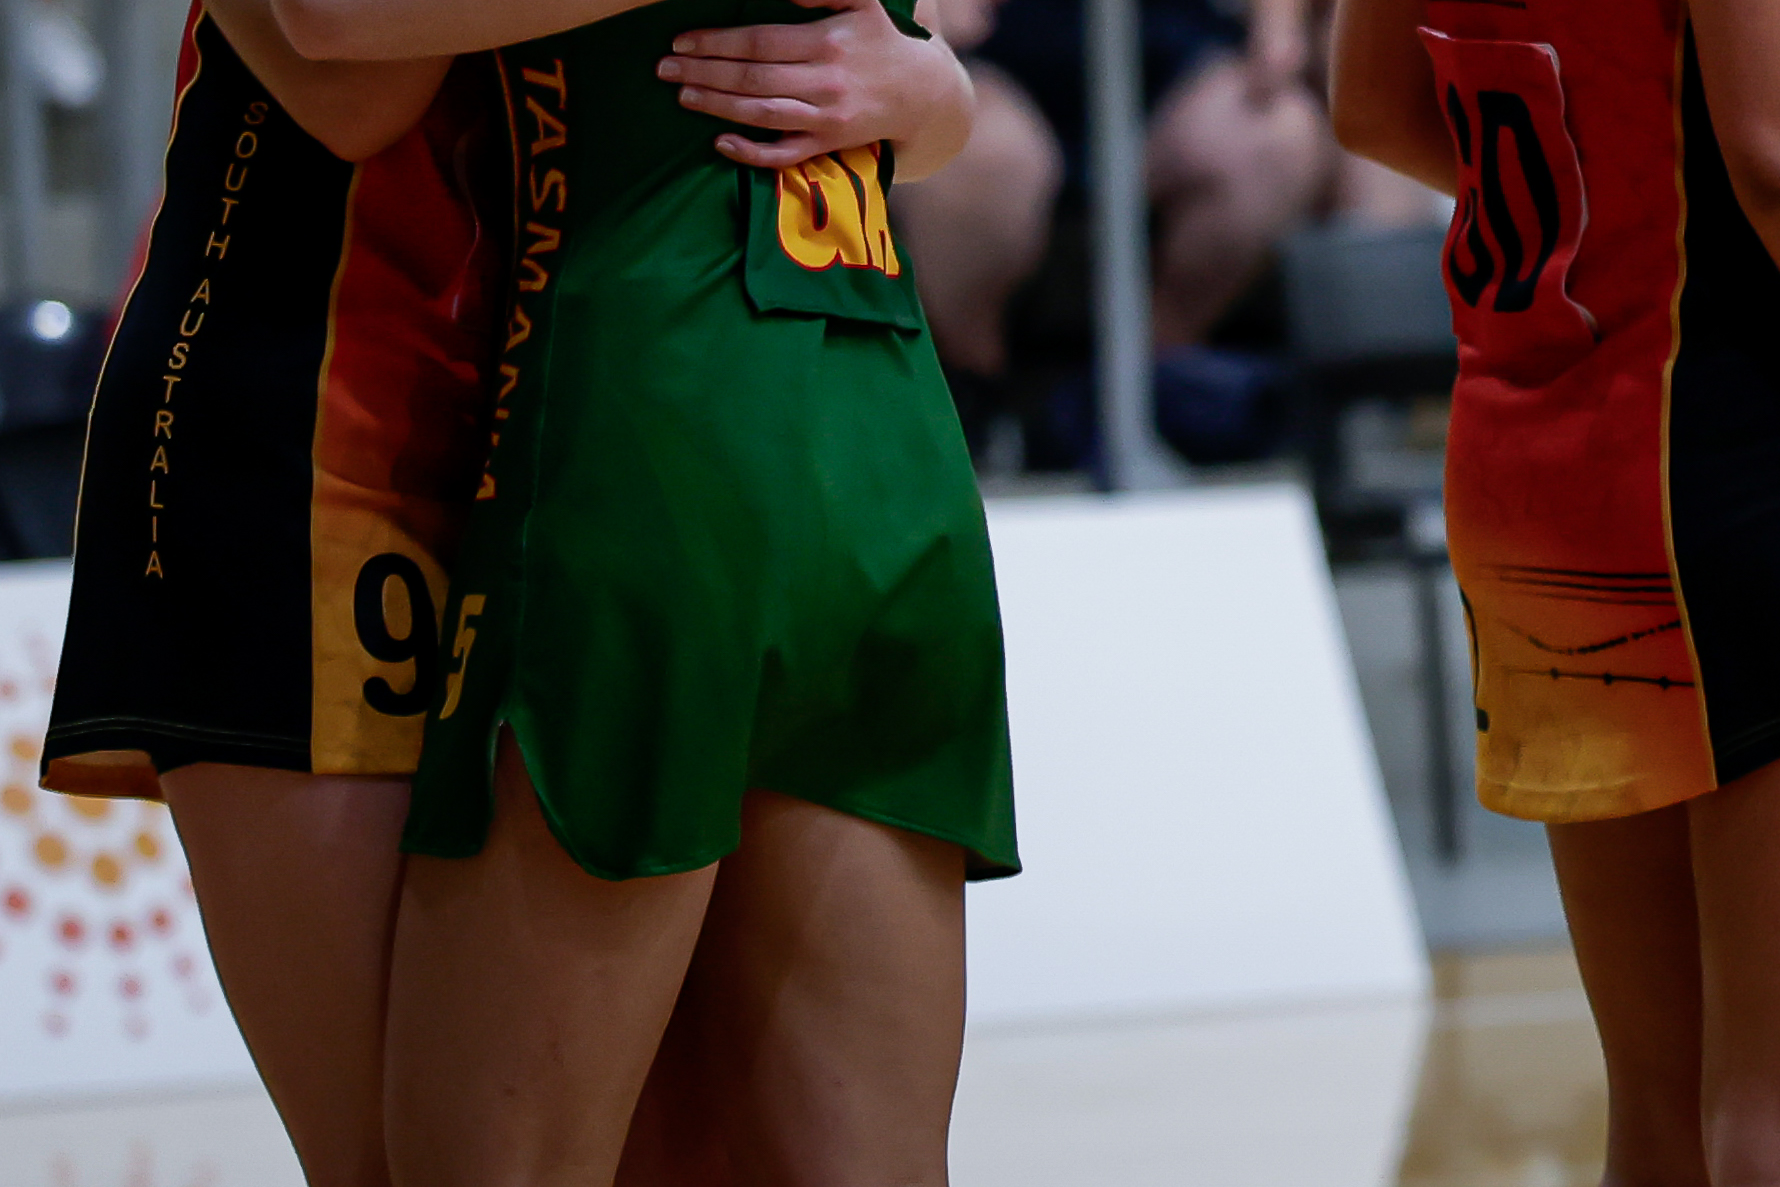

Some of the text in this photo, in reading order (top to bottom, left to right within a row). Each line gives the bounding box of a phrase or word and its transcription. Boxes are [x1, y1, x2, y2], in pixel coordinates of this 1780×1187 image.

[145, 100, 270, 579] SOUTH AUSTRALIA
[354, 552, 439, 717] 9
